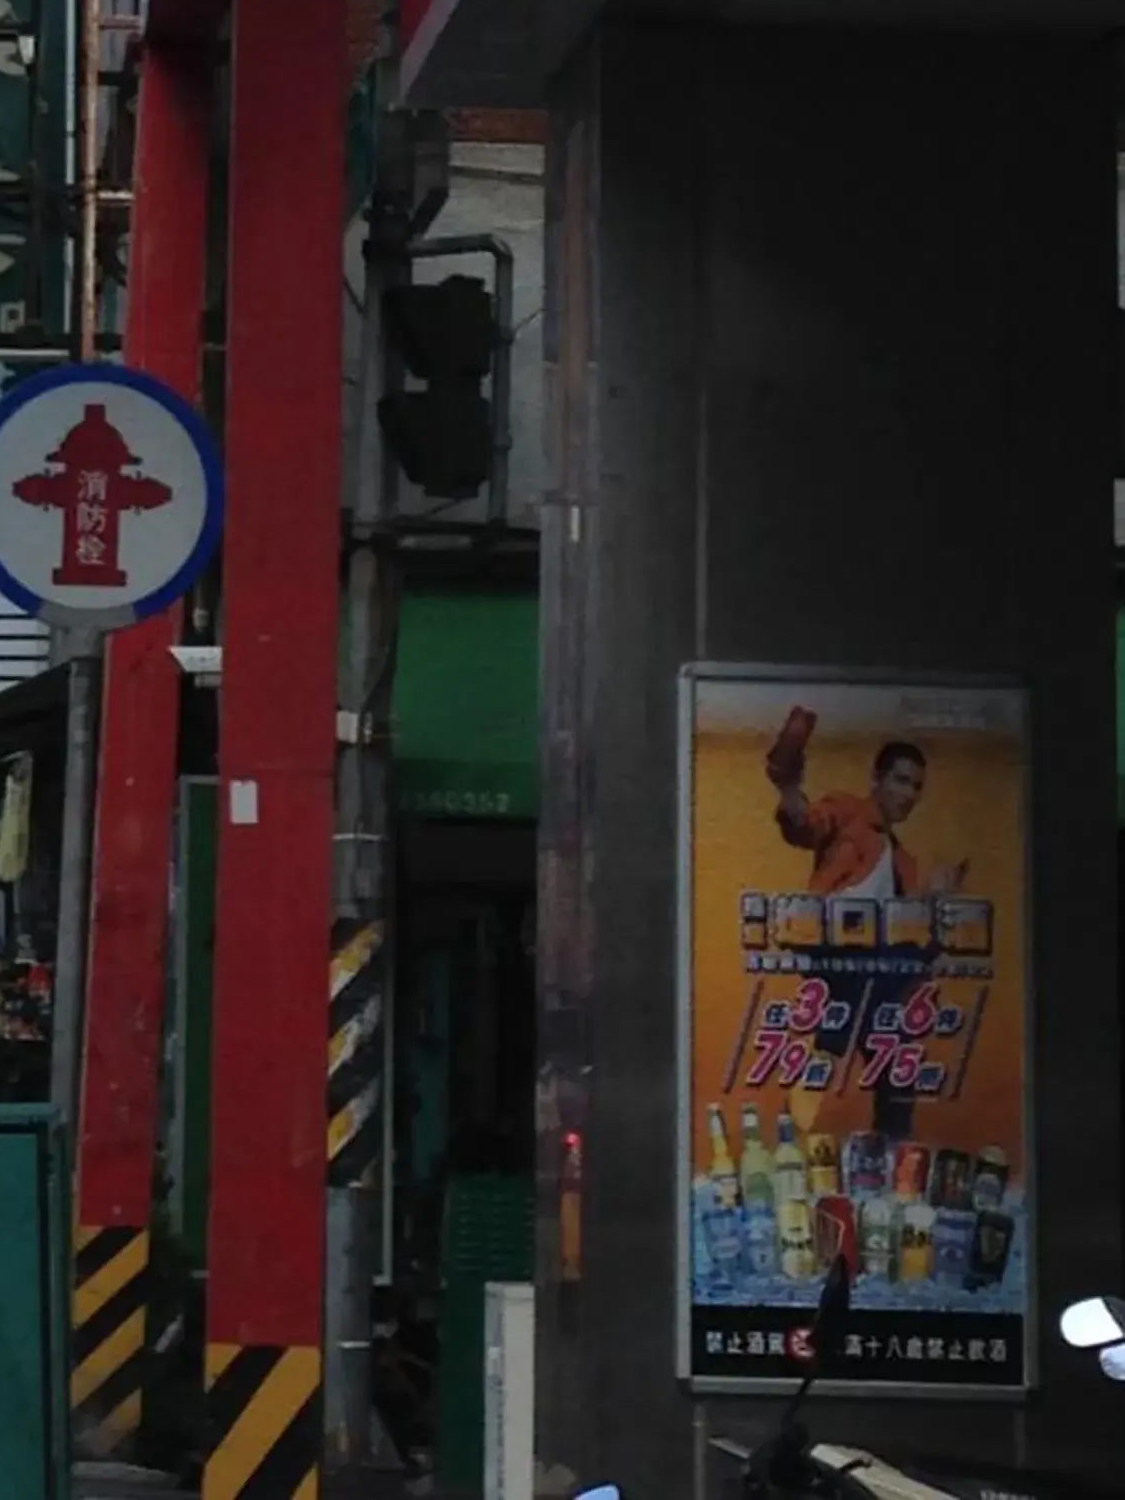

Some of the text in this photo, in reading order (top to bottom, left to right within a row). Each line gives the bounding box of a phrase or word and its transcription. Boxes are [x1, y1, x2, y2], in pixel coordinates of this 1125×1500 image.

[76, 469, 108, 566] 消防栓
[831, 1333, 1009, 1363] 滿十八歲禁止飲酒
